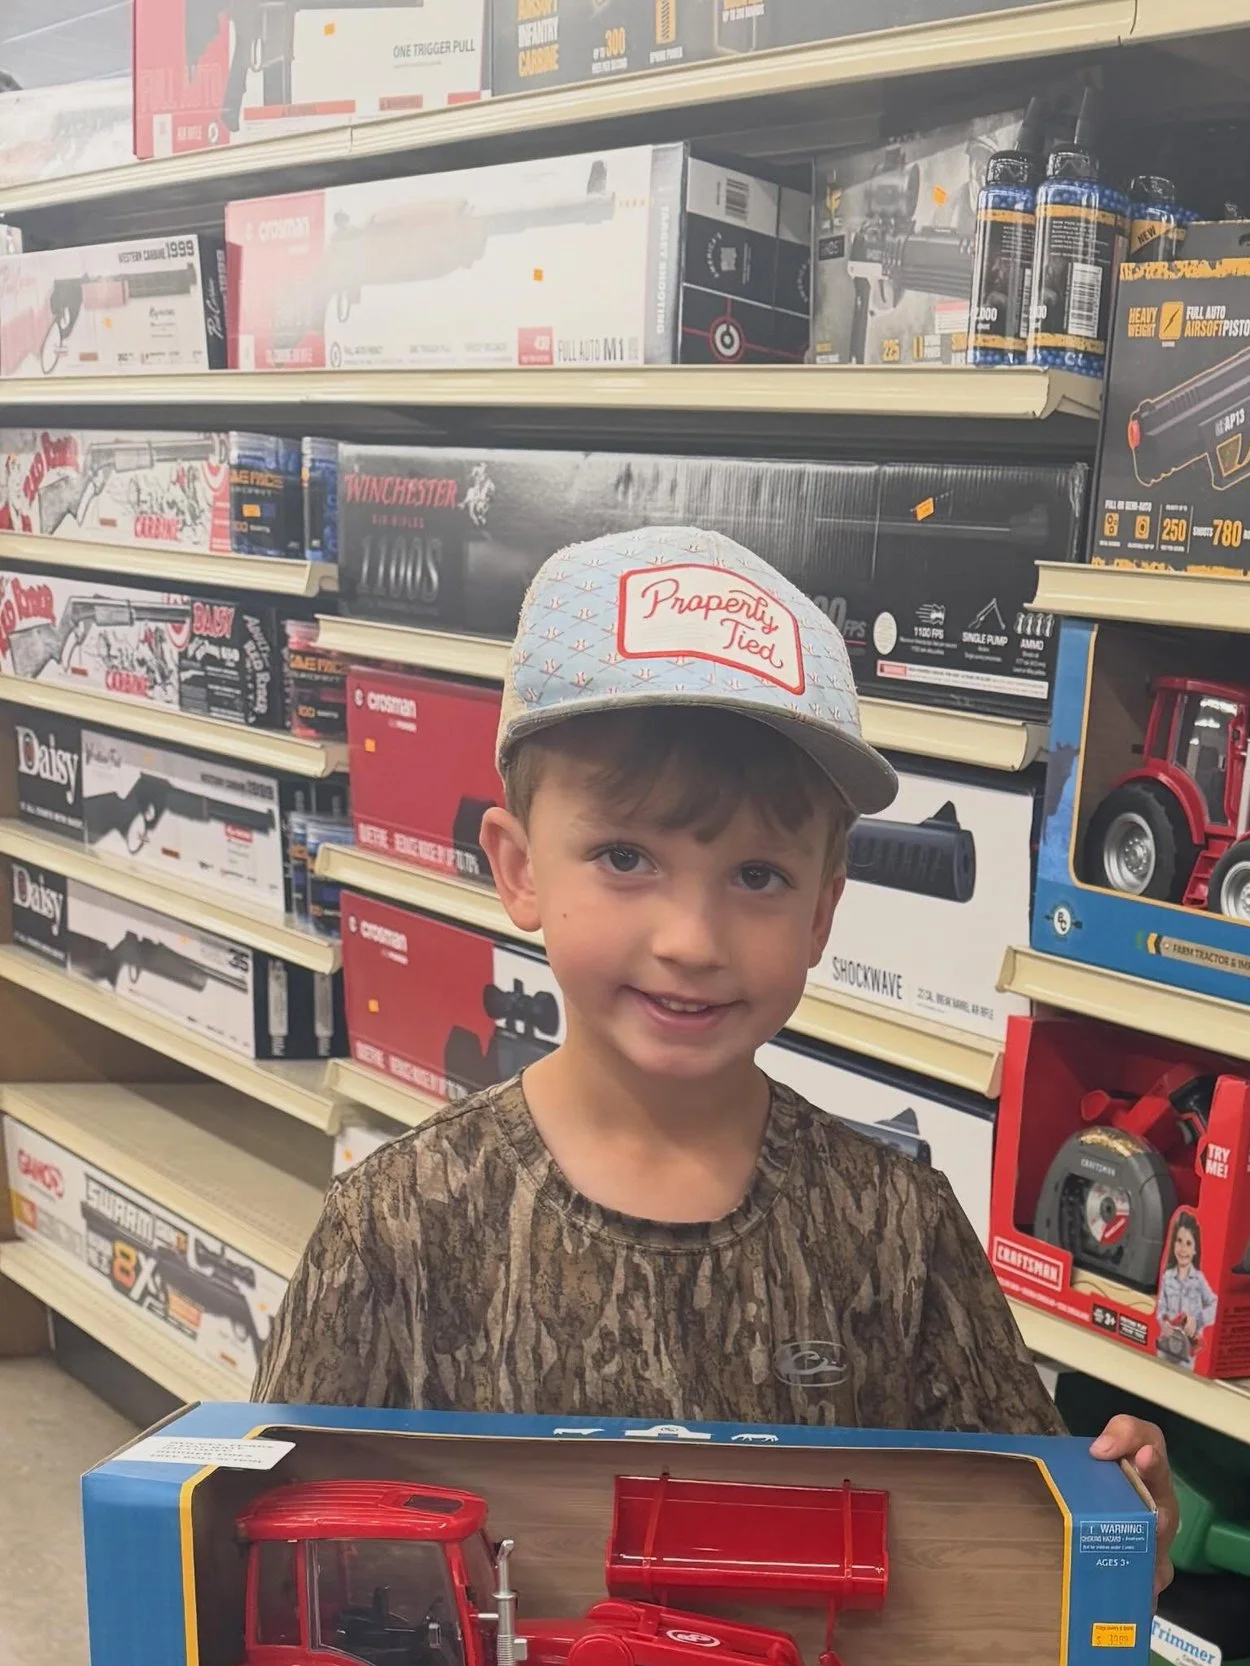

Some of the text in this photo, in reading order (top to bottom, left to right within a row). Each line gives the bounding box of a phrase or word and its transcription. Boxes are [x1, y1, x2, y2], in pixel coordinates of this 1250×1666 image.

[393, 39, 476, 58] ONE TRIGGER PULL
[1137, 225, 1158, 246] NEW
[166, 240, 195, 258] 1999
[1129, 308, 1157, 323] HEAVY
[1186, 306, 1226, 319] FULL AUTO
[1128, 323, 1157, 338] WEIGHT
[346, 471, 457, 509] WINCHESTER
[1161, 518, 1187, 541] 250
[1212, 519, 1243, 547] 780
[719, 620, 784, 670] Tied
[962, 632, 1008, 647] SINGLE PUMP
[1020, 639, 1044, 650] AMMO
[15, 725, 79, 805] Daisy
[12, 863, 64, 937] Daisy
[1195, 947, 1230, 967] TRACTOR
[831, 956, 903, 1001] SHOCKWAVE
[1207, 1143, 1231, 1164] TRY
[1205, 1160, 1229, 1179] ME!
[996, 1244, 1059, 1285] CRAFTSMAN
[1096, 1559, 1118, 1567] AGES
[1151, 1619, 1216, 1666] Trimmer
